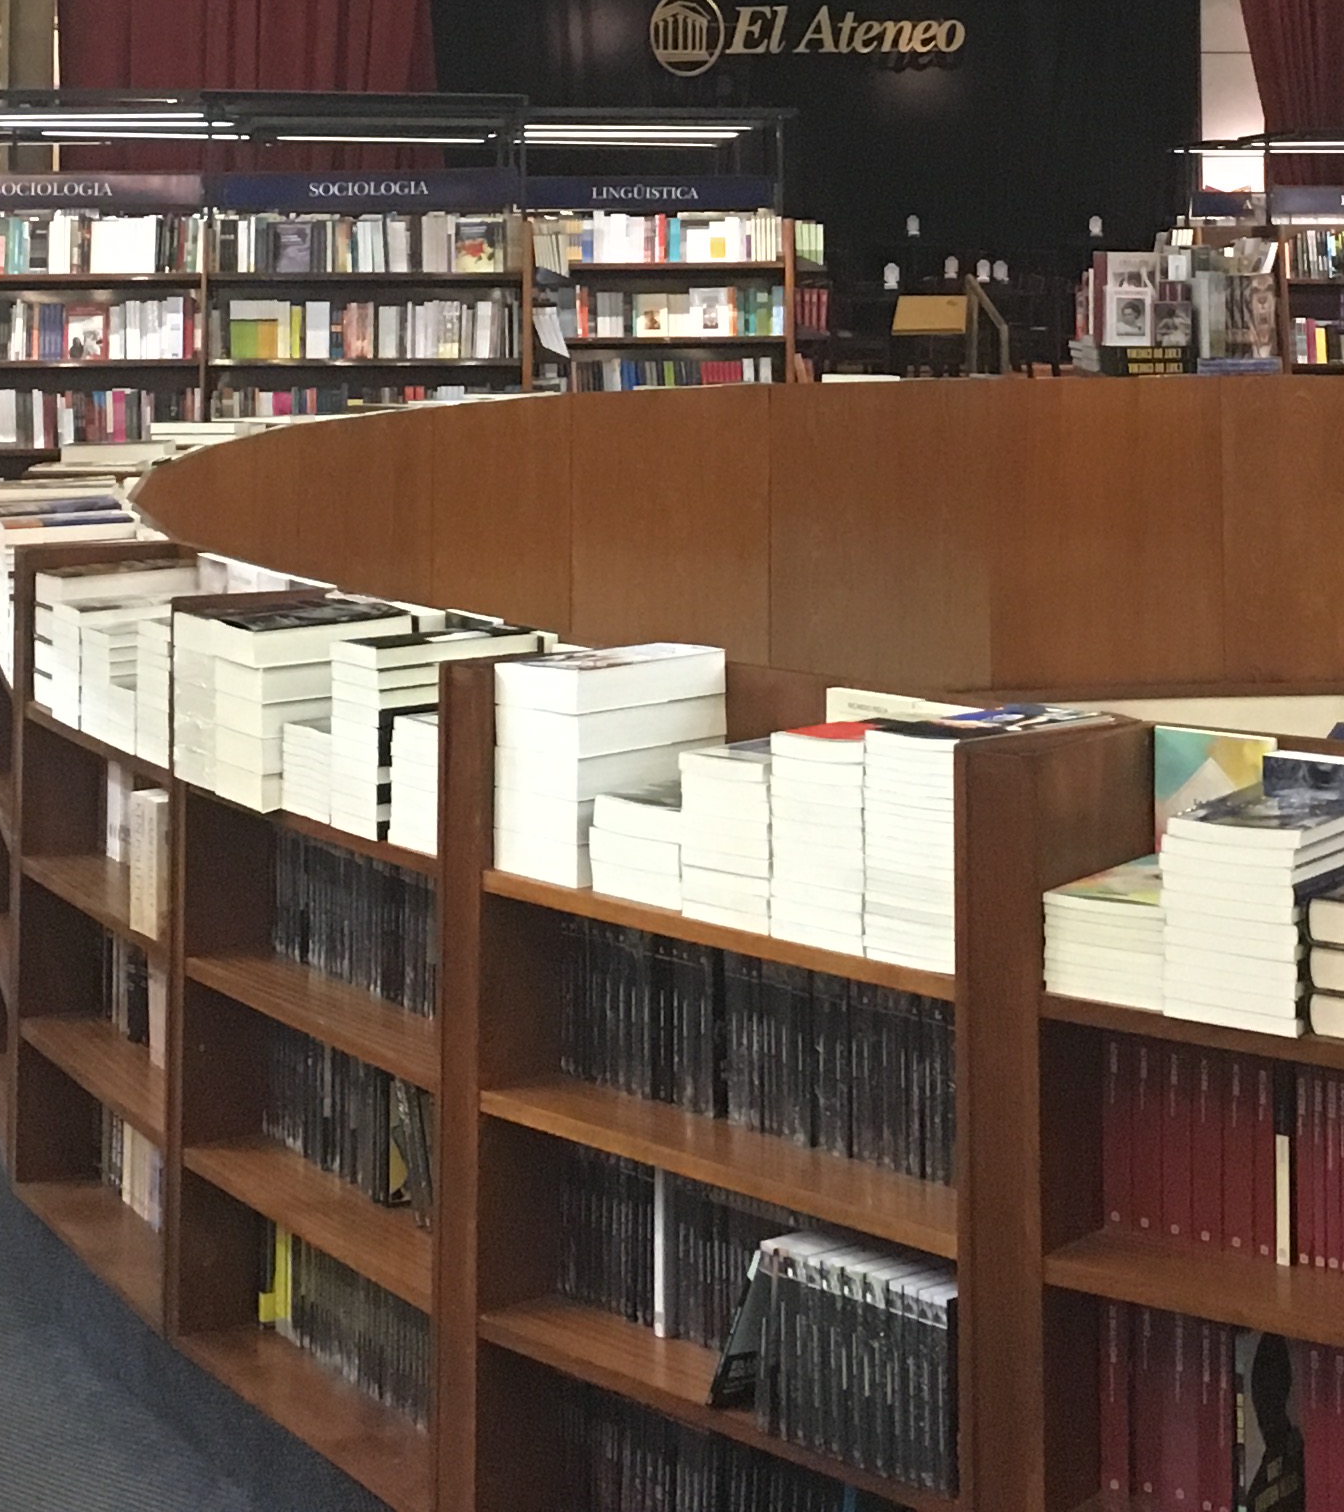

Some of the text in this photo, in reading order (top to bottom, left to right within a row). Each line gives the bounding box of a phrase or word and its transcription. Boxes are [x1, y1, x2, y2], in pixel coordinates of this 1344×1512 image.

[726, 5, 966, 55] El Ateneo
[308, 180, 429, 198] SOCIOLOGIA
